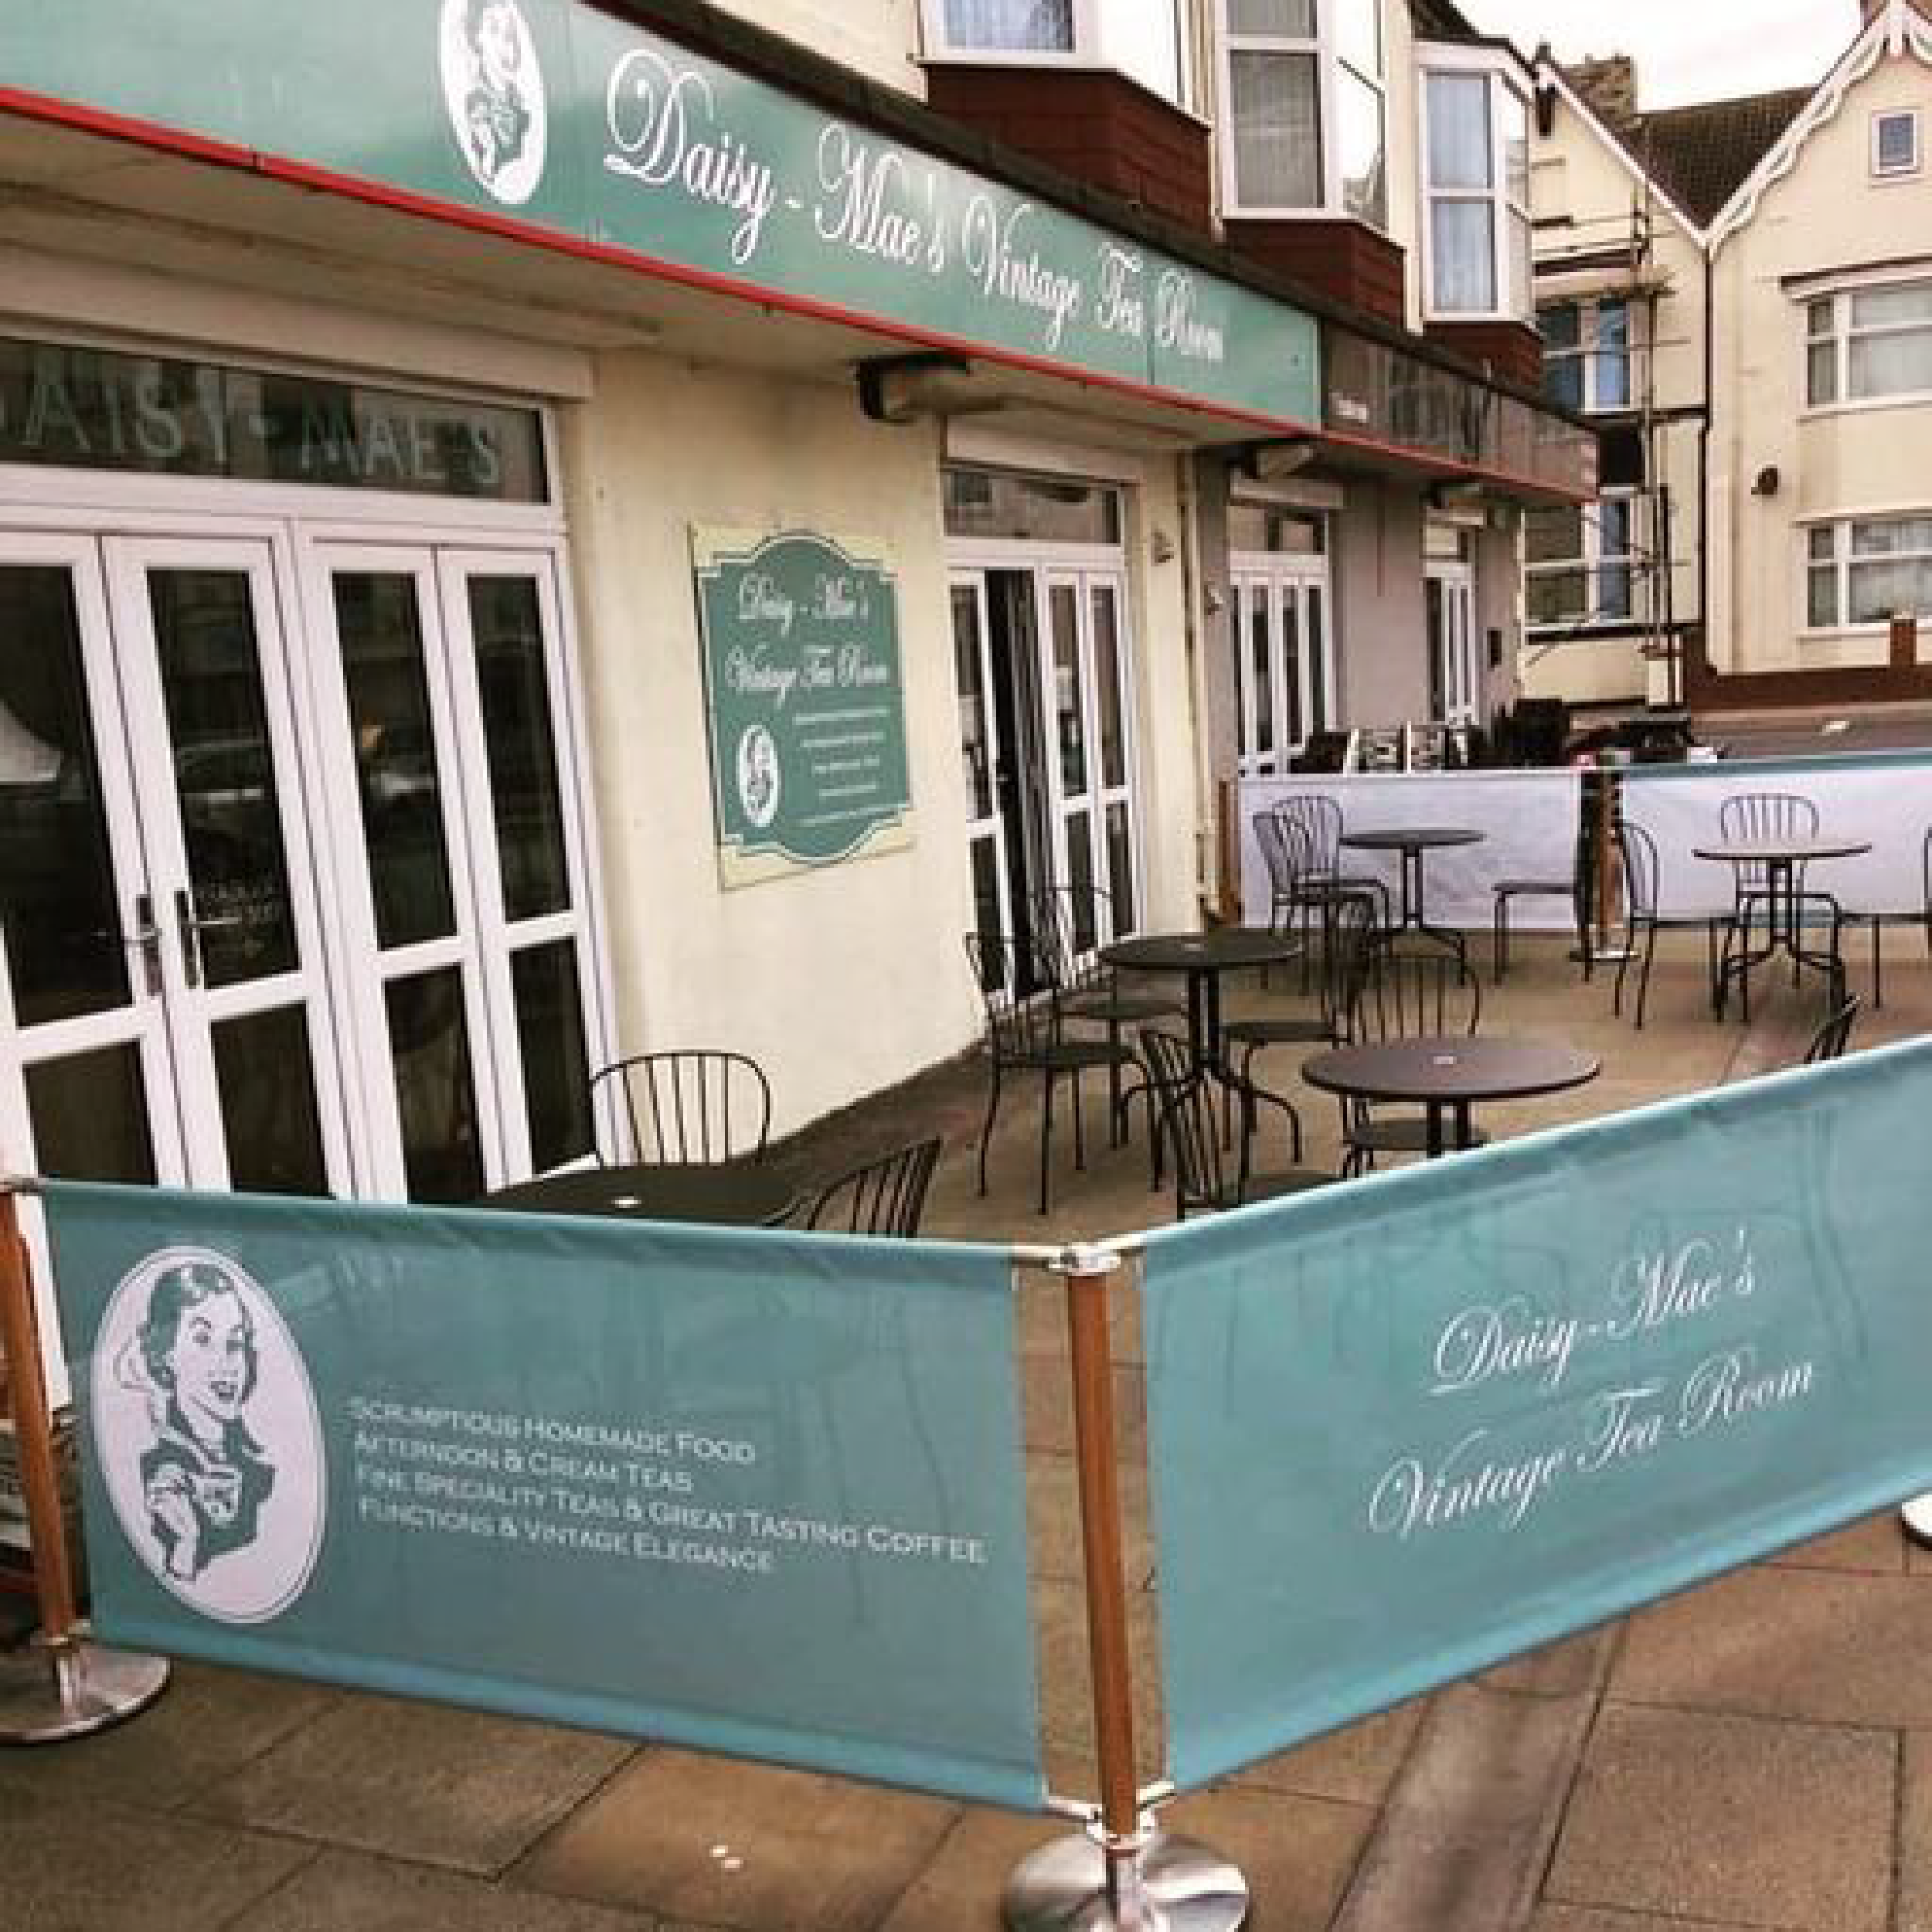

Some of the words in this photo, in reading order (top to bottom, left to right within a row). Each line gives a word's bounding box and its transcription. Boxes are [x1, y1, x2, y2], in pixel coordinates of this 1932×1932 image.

[602, 49, 776, 265] Daisy
[961, 192, 1081, 351] Vintage
[1094, 240, 1145, 337] Tea
[1155, 266, 1224, 362] Room
[1367, 1428, 1566, 1540] Vintage
[1577, 1379, 1666, 1474] Tea
[1677, 1345, 1813, 1439] Room
